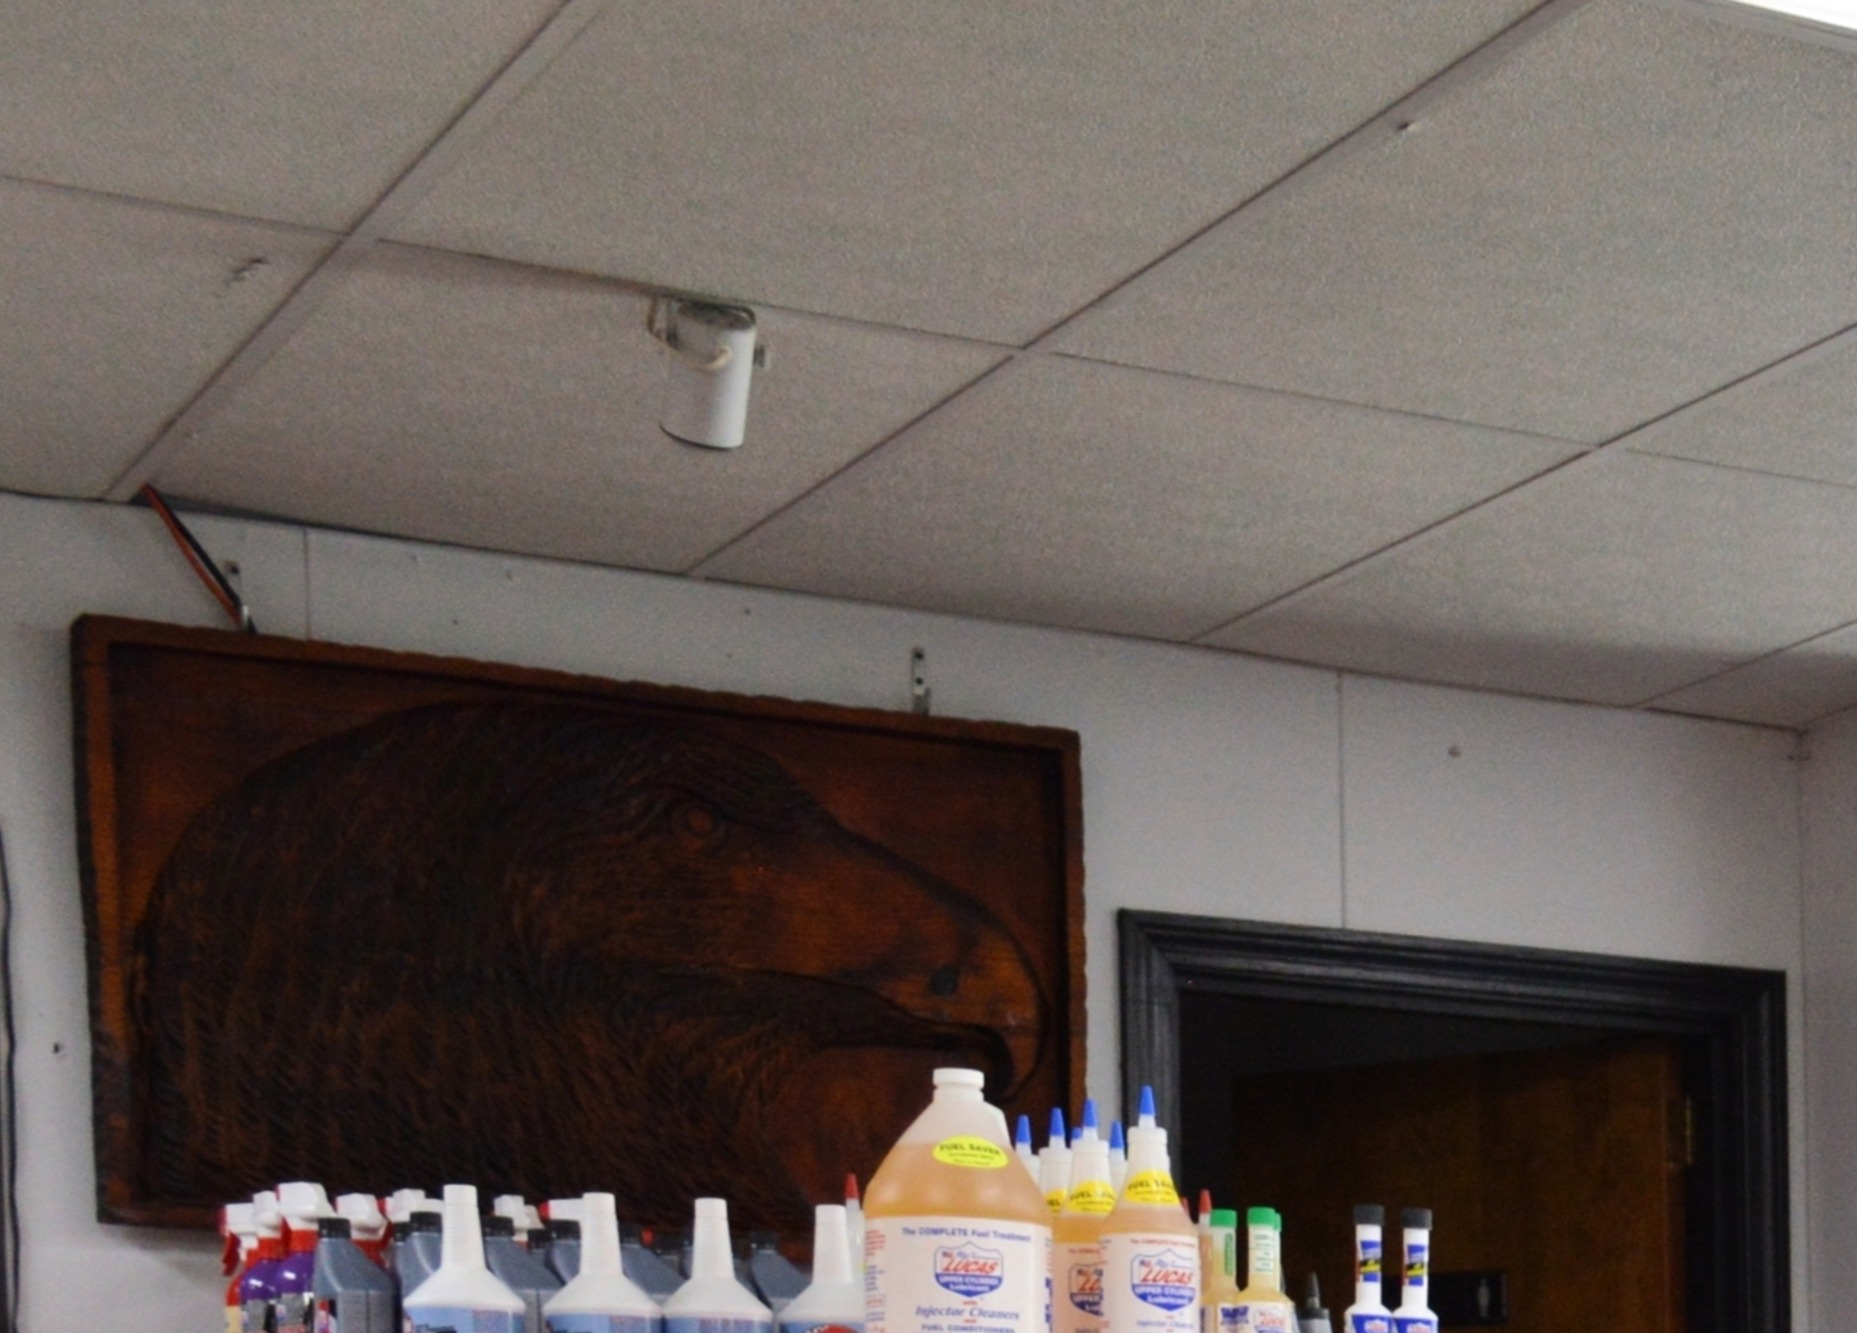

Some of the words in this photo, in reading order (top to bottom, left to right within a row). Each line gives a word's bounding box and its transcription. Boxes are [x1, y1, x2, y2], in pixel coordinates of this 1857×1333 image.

[919, 1227, 968, 1238] COMPLETE
[971, 1229, 990, 1239] Fuel
[941, 1256, 999, 1275] LUCAS
[1140, 1268, 1194, 1285] LUCAS
[915, 1305, 964, 1319] Injector
[969, 1306, 1020, 1320] Cleaners
